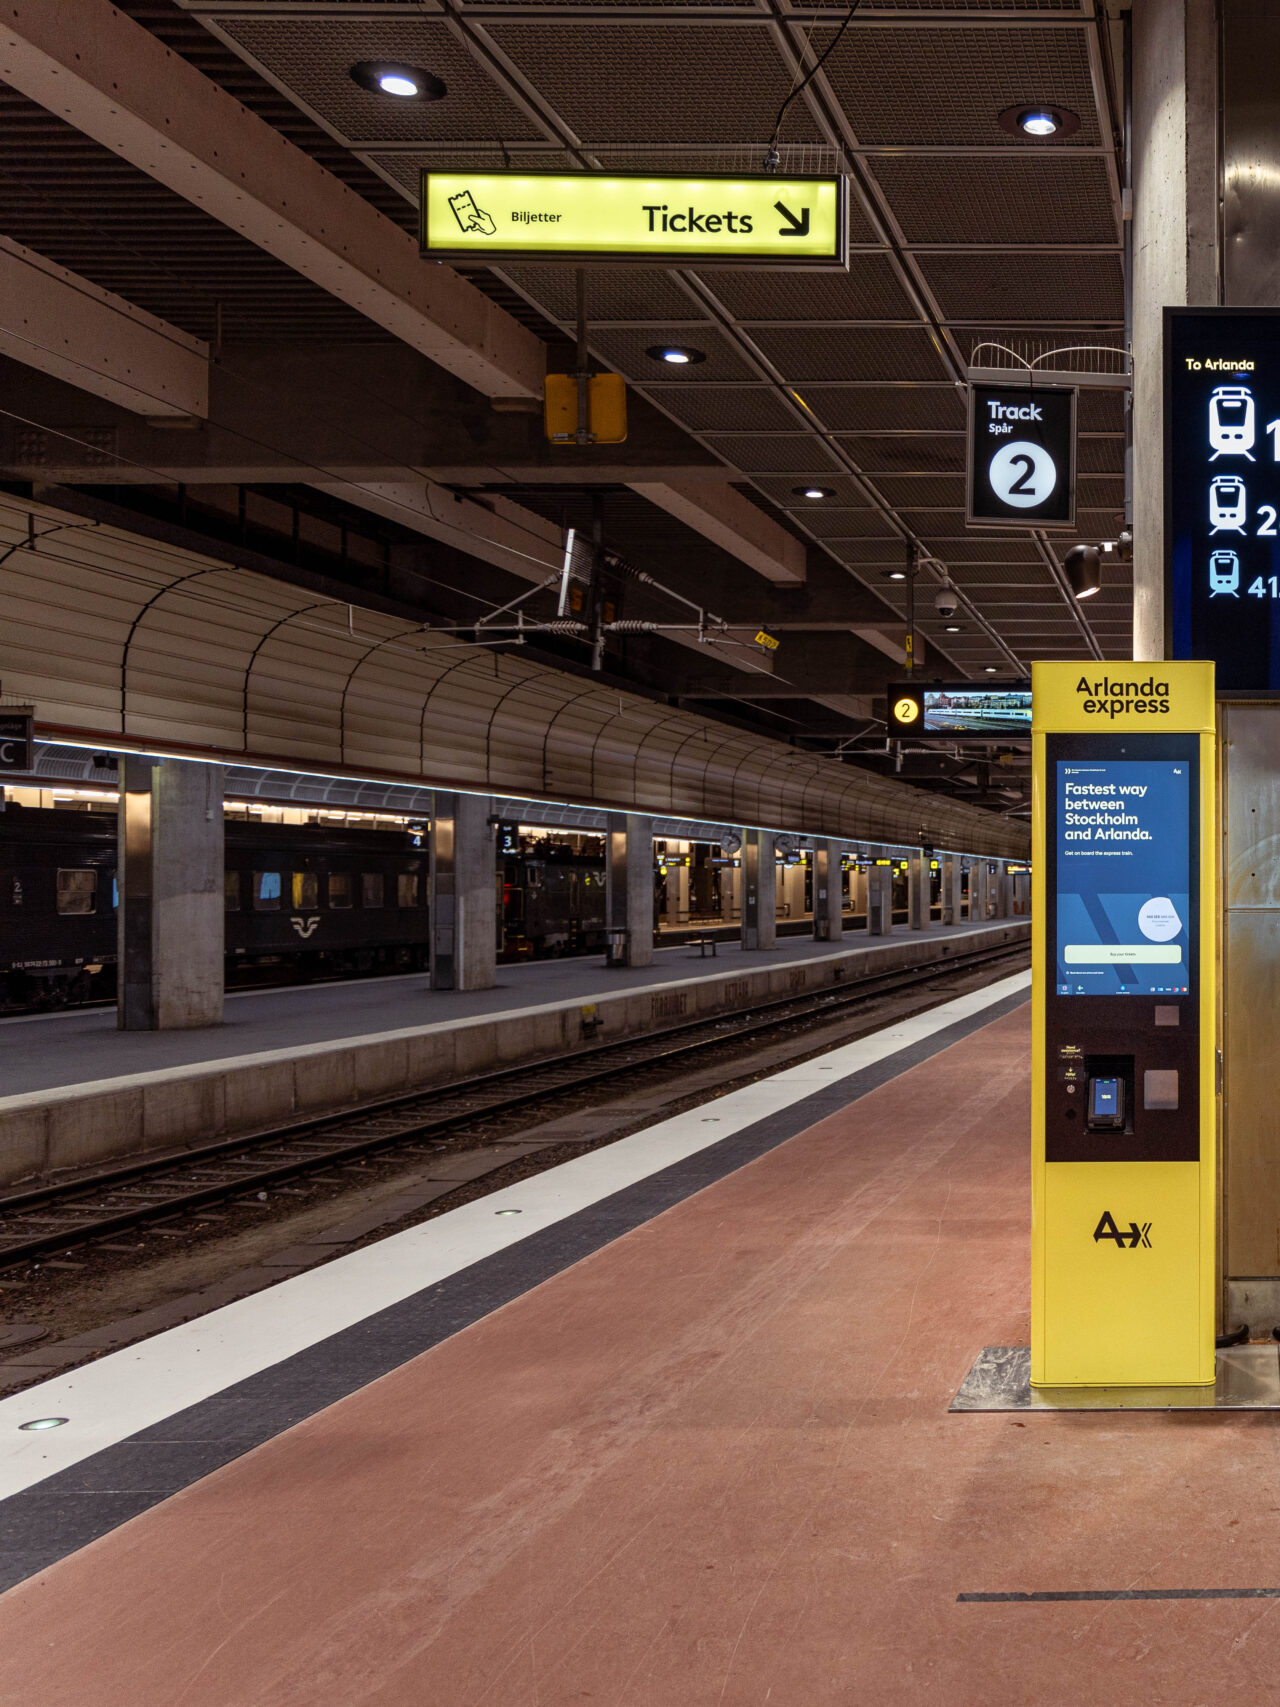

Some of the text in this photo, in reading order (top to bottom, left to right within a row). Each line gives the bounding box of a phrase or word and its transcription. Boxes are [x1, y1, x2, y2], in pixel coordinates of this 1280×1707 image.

[512, 211, 562, 225] Biljetter
[643, 205, 753, 234] Tickets
[1186, 358, 1255, 370] To Arlanda
[988, 401, 1042, 421] Track
[989, 422, 1013, 436] Spår
[1009, 454, 1036, 496] 2
[1247, 576, 1278, 599] 41
[1077, 677, 1170, 697] Arlanda
[901, 703, 911, 718] 2
[1083, 700, 1170, 719] express
[0, 743, 14, 763] C
[1065, 783, 1148, 797] Fastest way
[1065, 798, 1125, 810] between
[1065, 812, 1139, 825] Stockholm
[1064, 827, 1153, 840] and Arlanda.
[413, 836, 422, 846] 4
[503, 836, 512, 847] 3
[14, 882, 22, 892] 2
